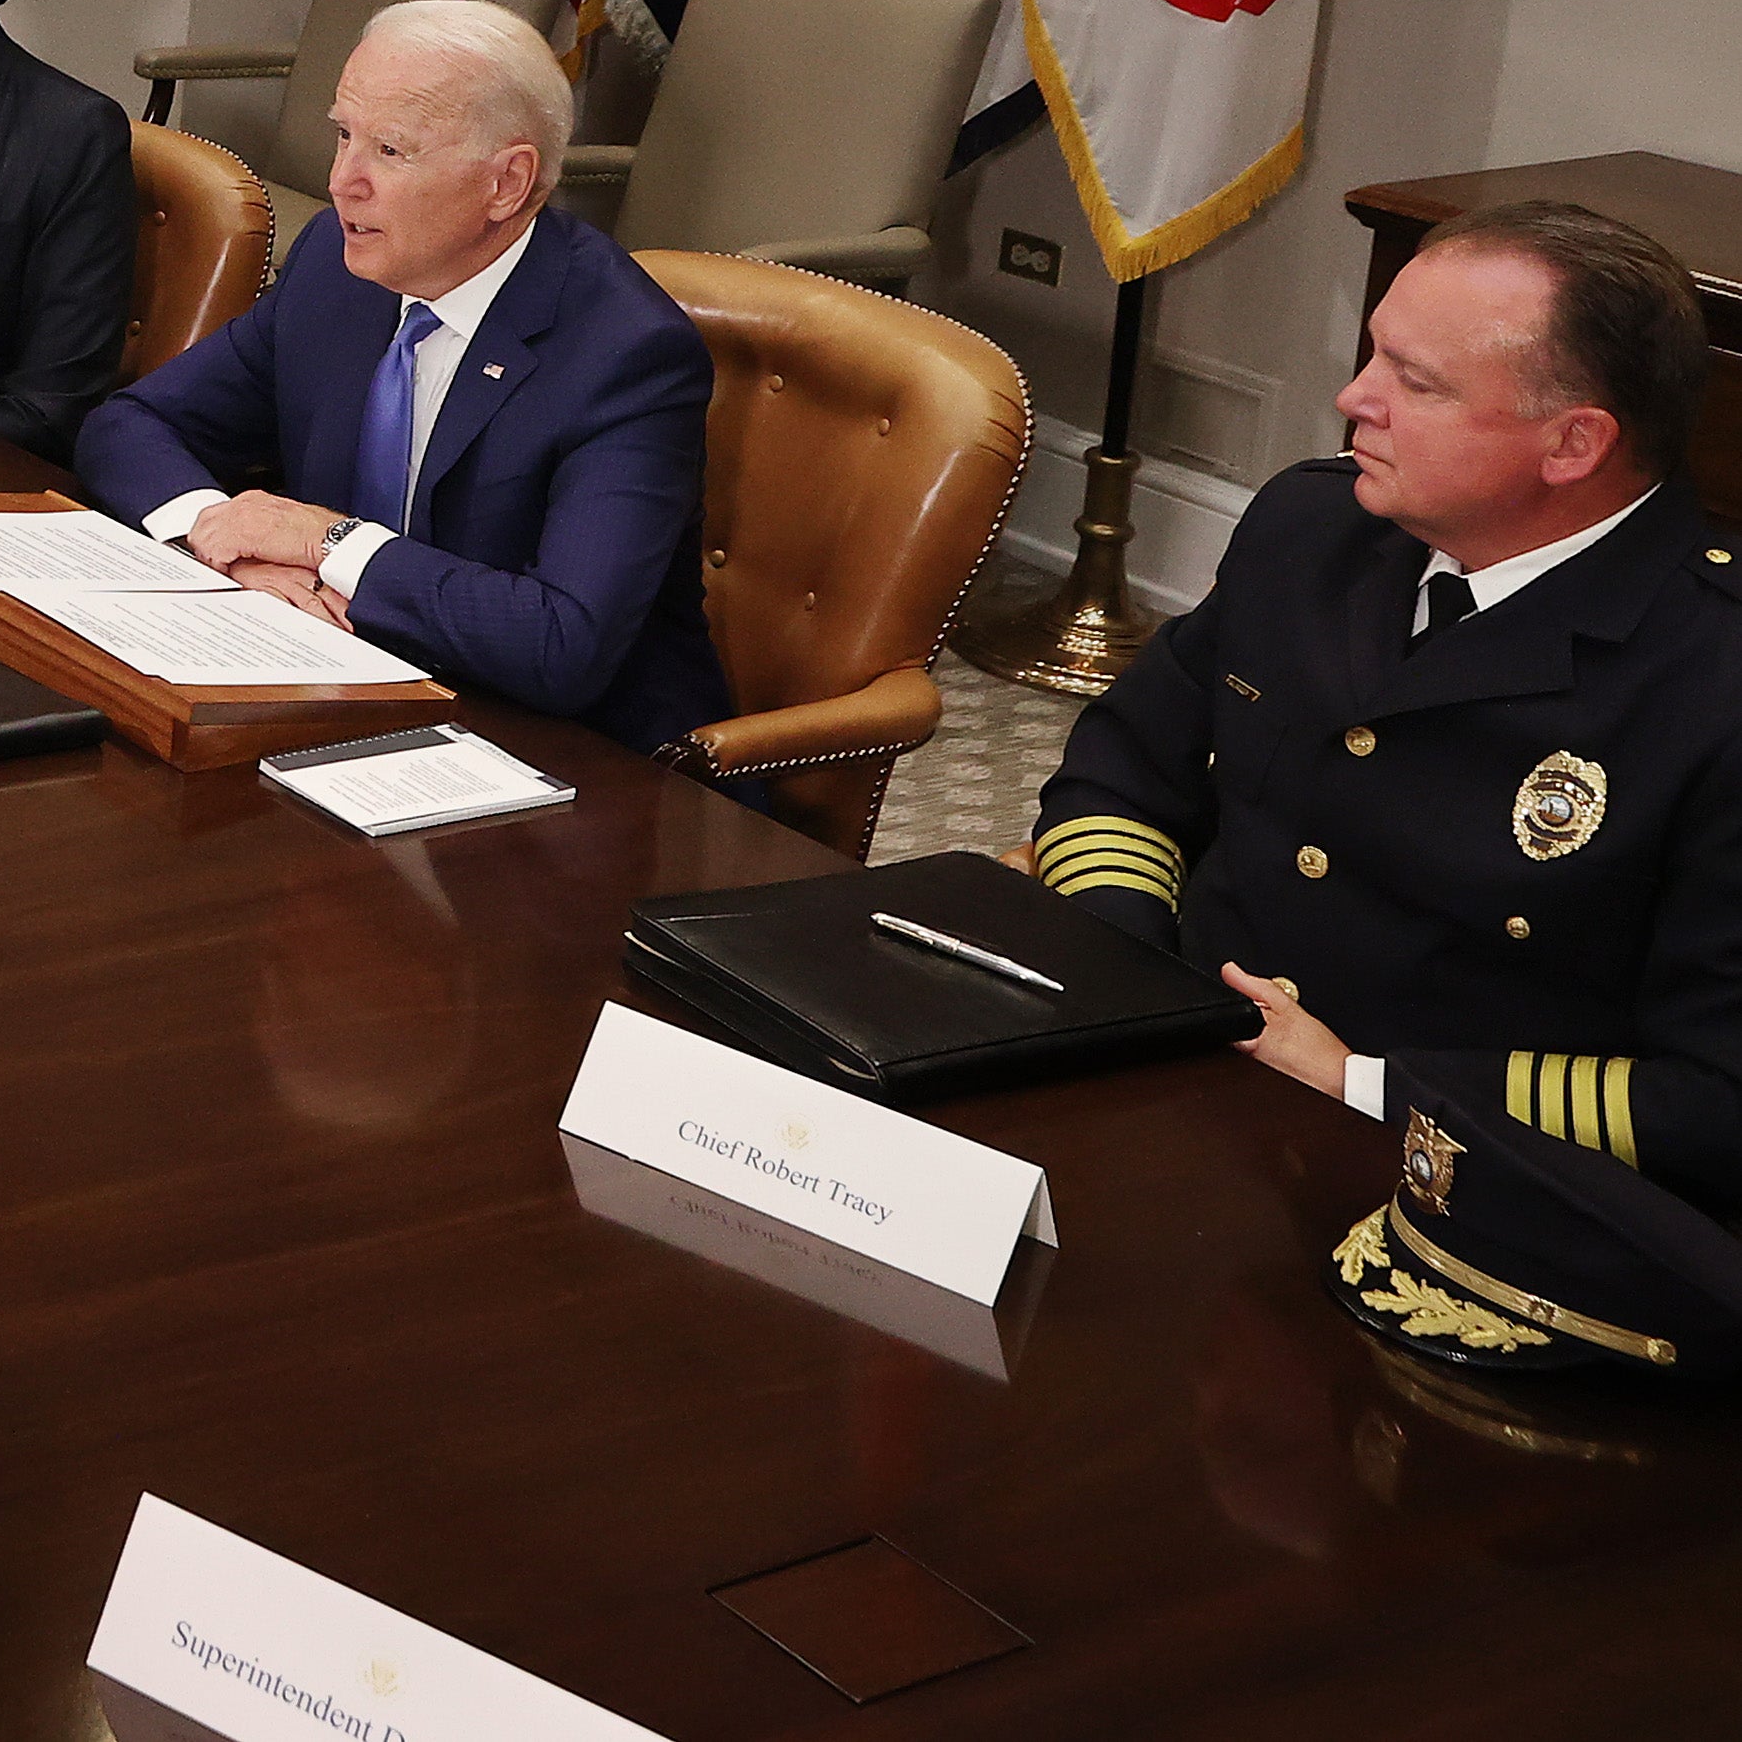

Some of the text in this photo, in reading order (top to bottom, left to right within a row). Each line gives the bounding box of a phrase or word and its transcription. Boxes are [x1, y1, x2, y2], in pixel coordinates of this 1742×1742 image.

[677, 1119, 895, 1227] Chief Robert Tracy
[169, 1618, 376, 1742] Superintendent
